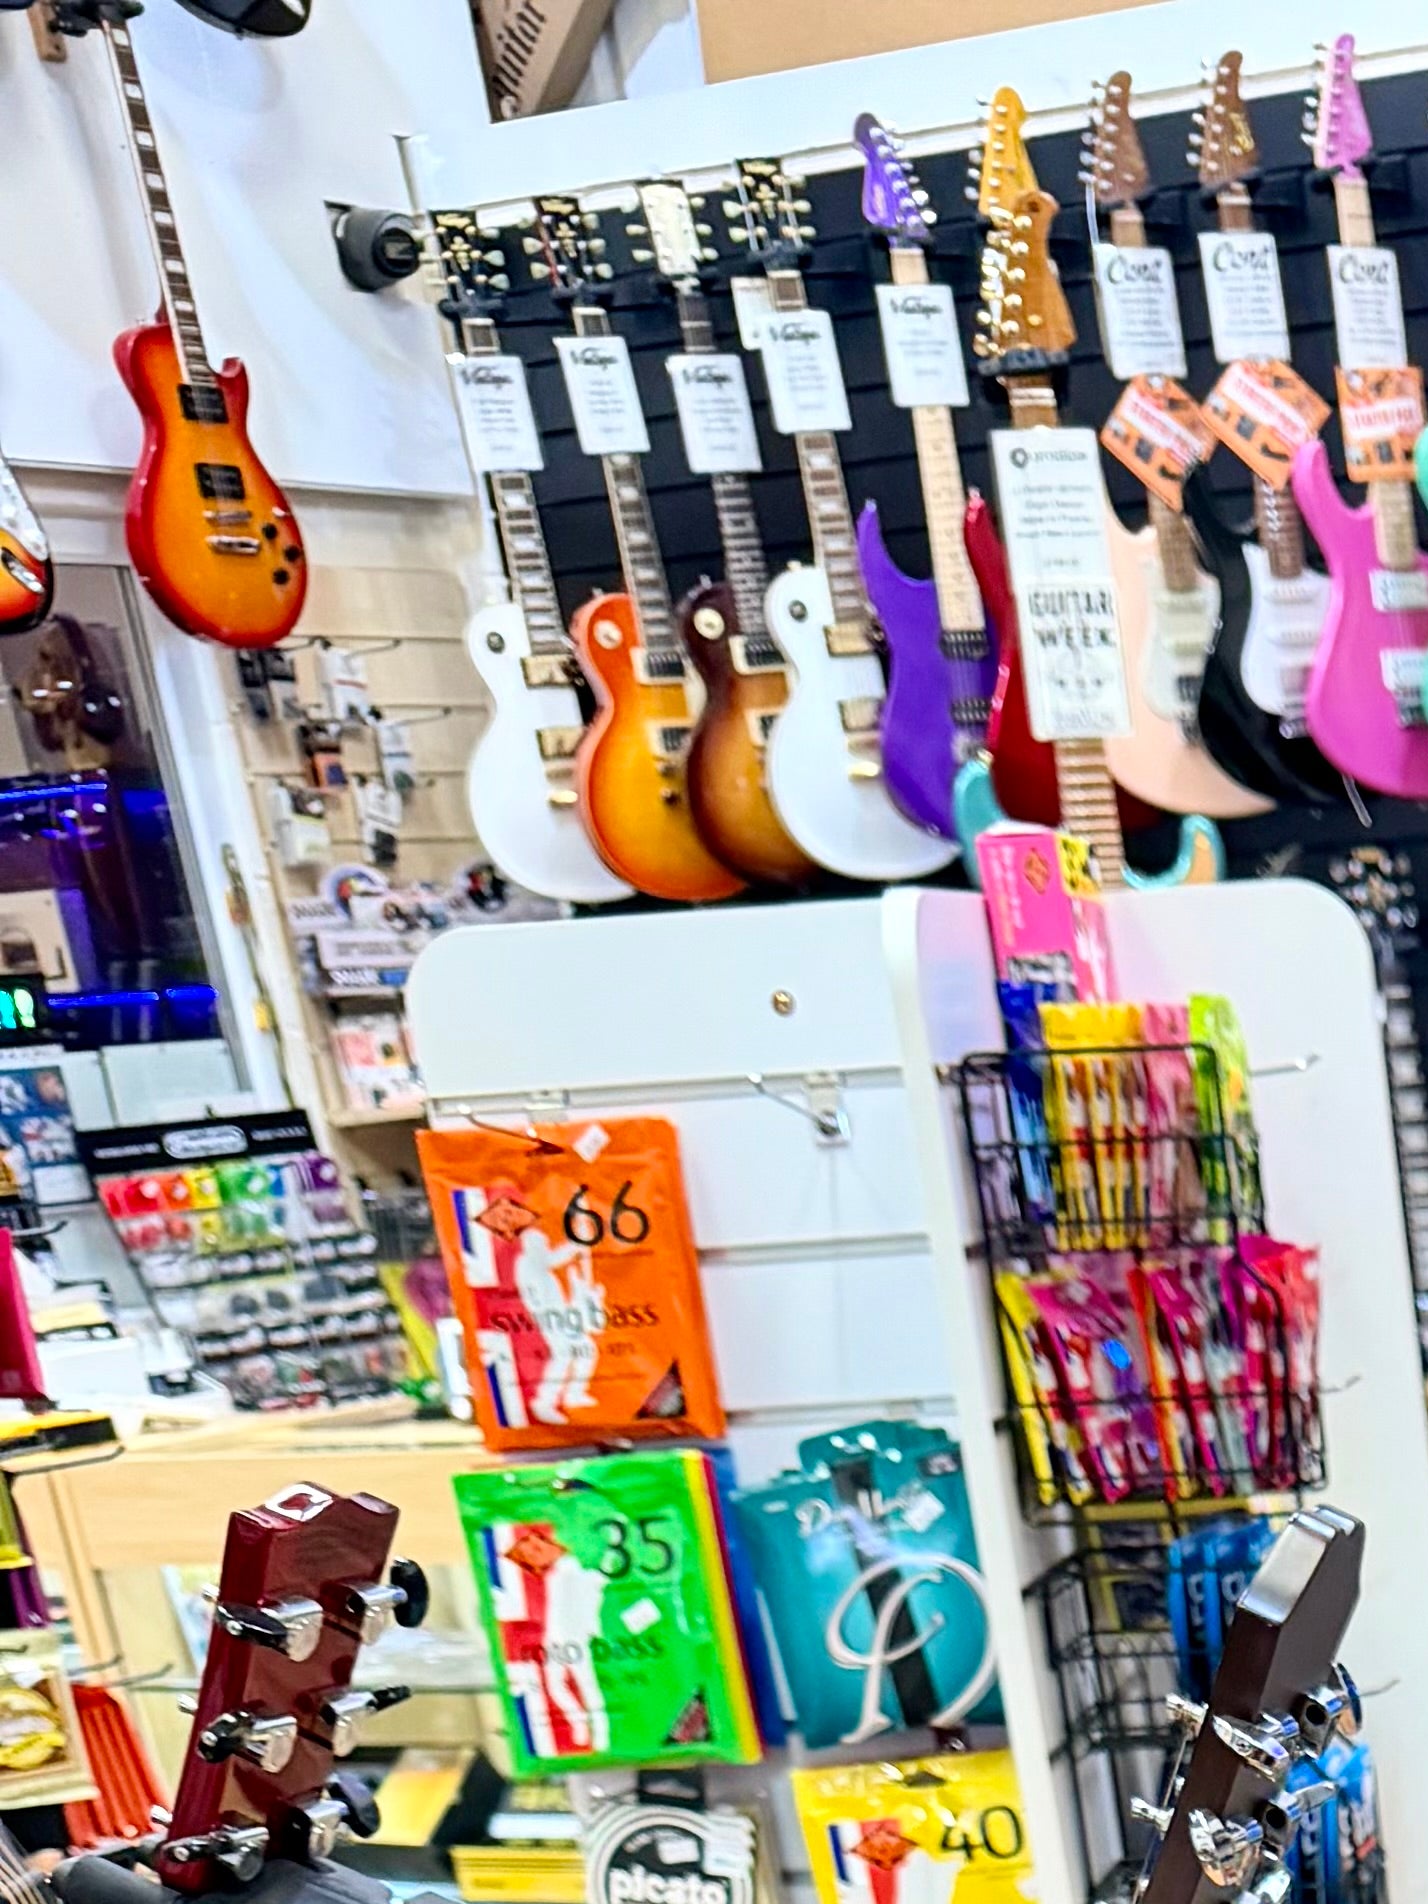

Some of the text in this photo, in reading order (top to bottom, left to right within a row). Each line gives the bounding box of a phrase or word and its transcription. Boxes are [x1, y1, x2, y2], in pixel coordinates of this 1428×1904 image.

[563, 1180, 651, 1246] 66
[490, 1303, 584, 1338] swng
[596, 1516, 674, 1579] 35
[940, 1805, 1024, 1863] 40
